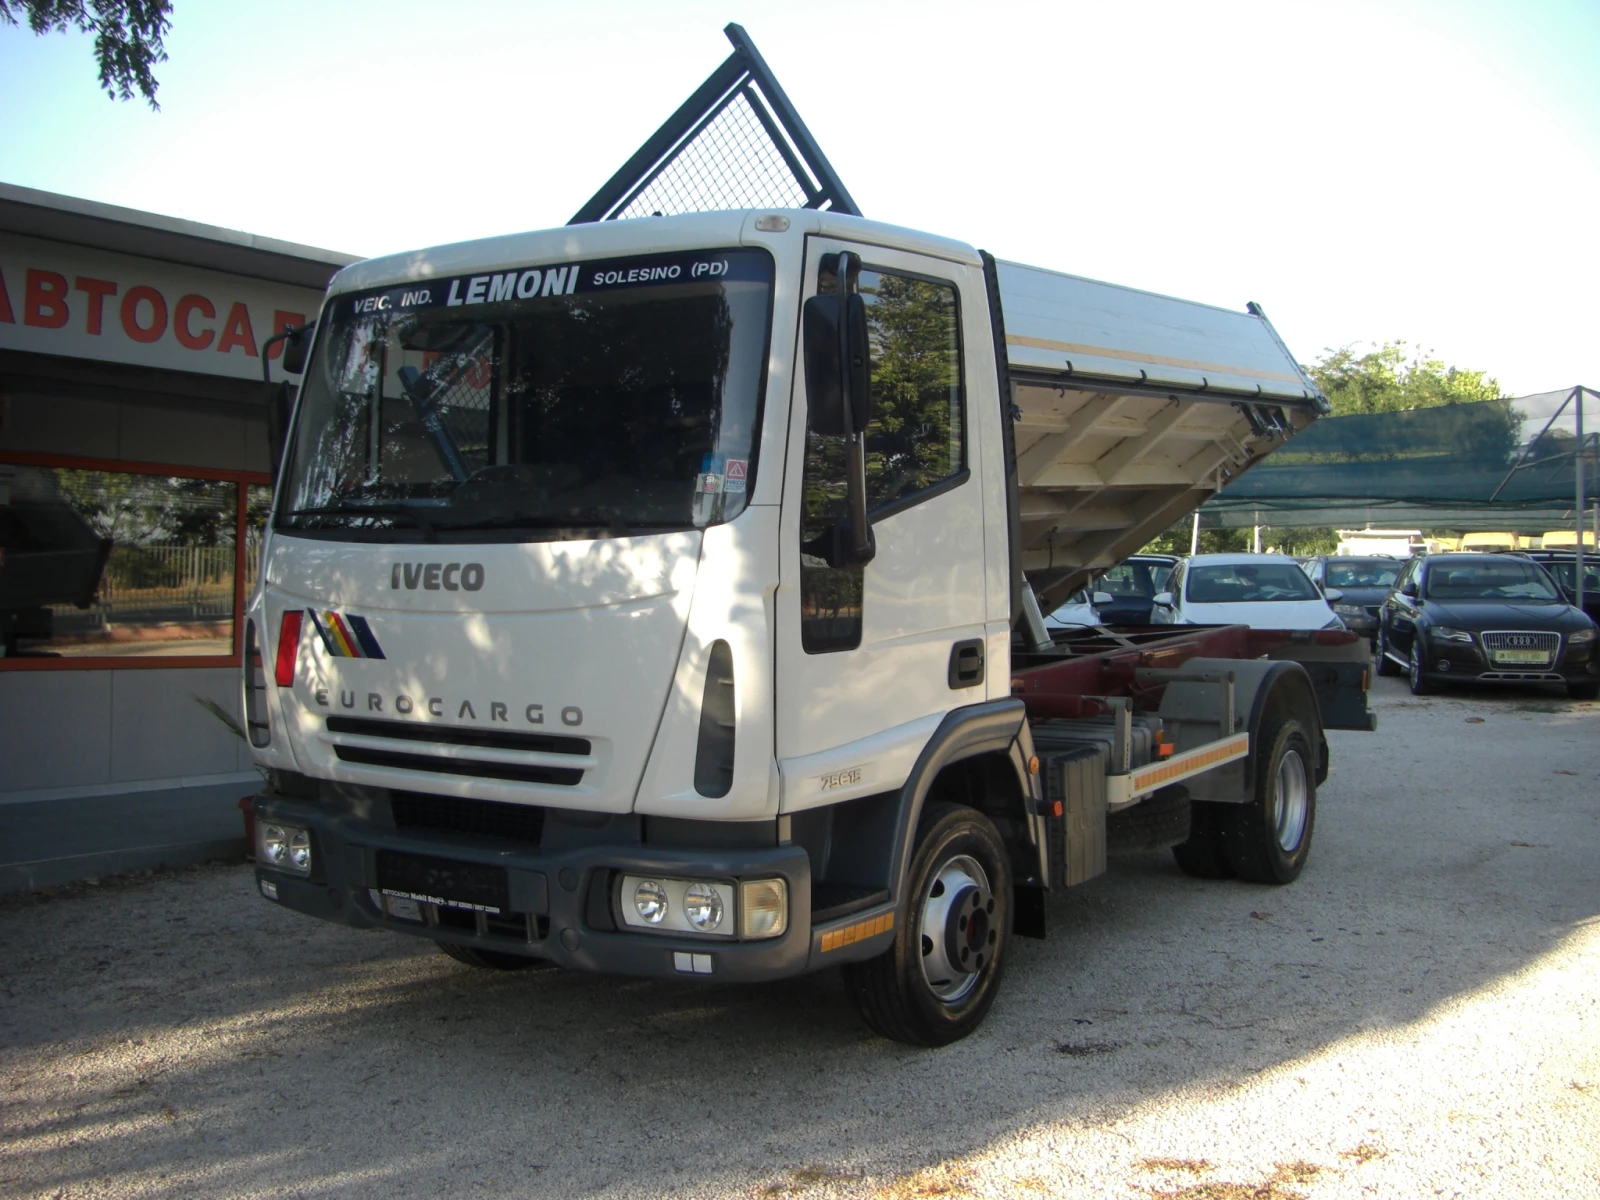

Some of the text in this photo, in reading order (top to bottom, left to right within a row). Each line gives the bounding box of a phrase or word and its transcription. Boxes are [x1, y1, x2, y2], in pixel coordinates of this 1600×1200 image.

[353, 260, 729, 314] VEIC. IND. LEMONI SOLESINO (PD)
[391, 562, 485, 592] IVECO
[315, 688, 584, 727] EUROCARGO
